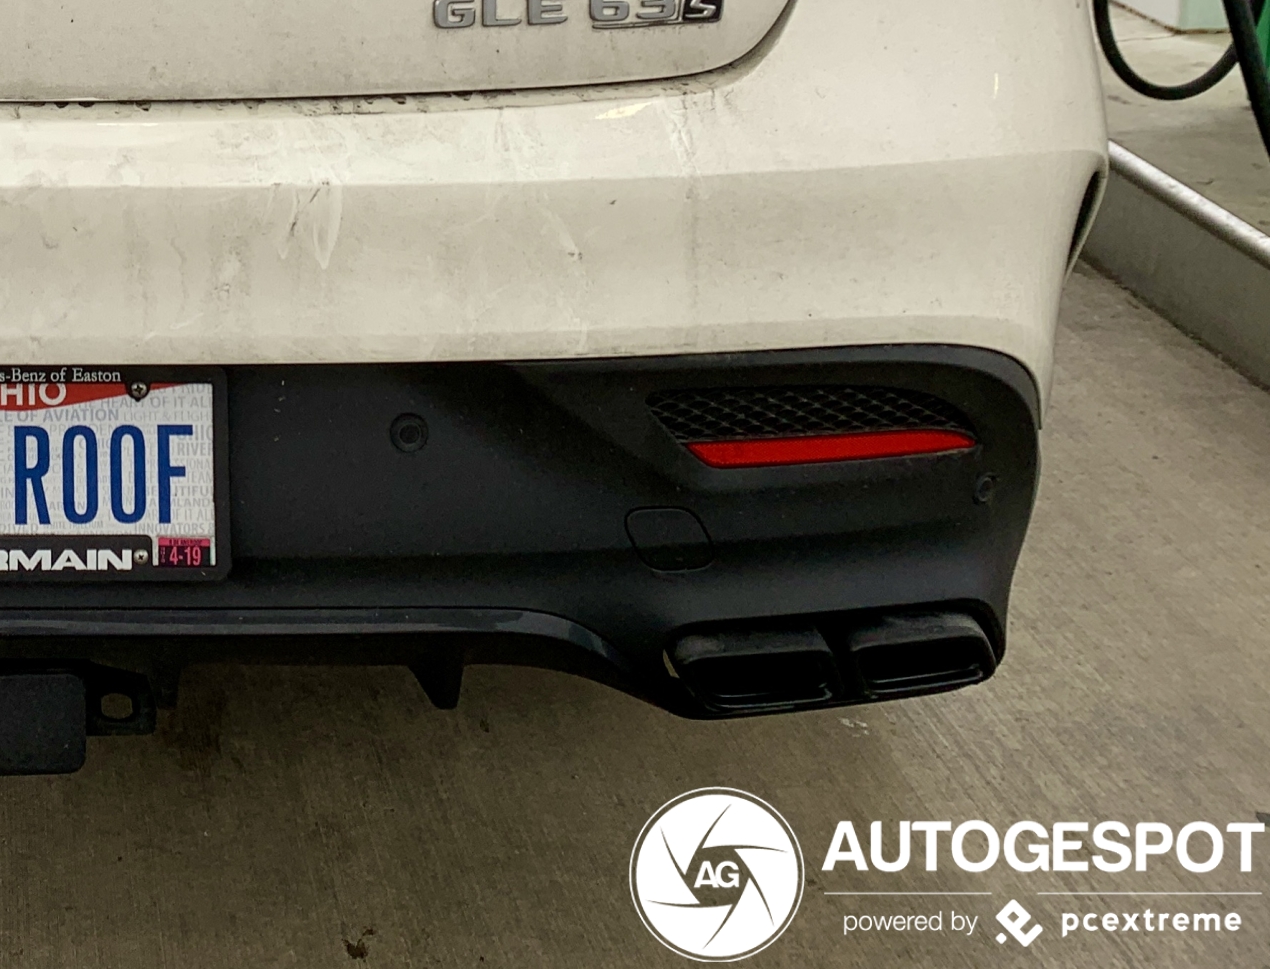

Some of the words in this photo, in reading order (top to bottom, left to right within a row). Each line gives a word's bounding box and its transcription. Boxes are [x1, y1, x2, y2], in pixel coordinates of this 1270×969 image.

[50, 367, 67, 383] of
[71, 368, 121, 383] Easton
[17, 409, 38, 423] OF
[42, 408, 119, 422] AVIATION
[14, 424, 194, 527] ROOF
[169, 546, 202, 566] 4-19
